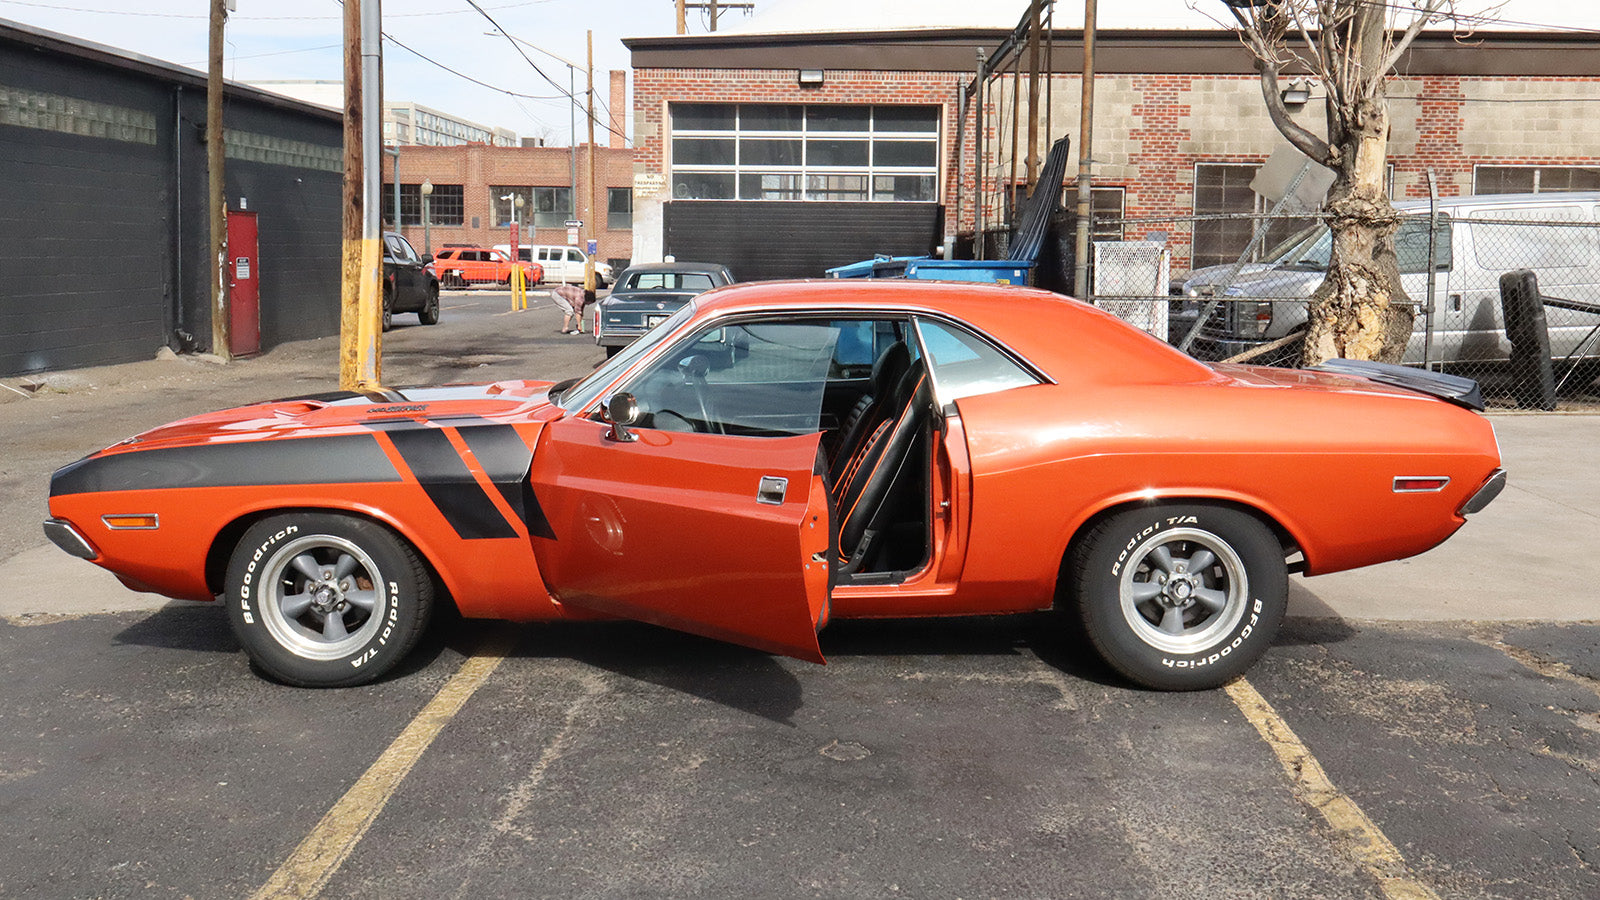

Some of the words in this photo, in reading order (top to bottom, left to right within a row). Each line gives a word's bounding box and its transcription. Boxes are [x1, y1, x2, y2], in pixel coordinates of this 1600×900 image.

[240, 524, 298, 624] BFGoodrich
[1111, 521, 1160, 577] Radial
[1166, 515, 1198, 525] T/A
[379, 581, 399, 646] Radial
[1162, 598, 1263, 669] BFGoodrich
[351, 647, 379, 668] T/A
